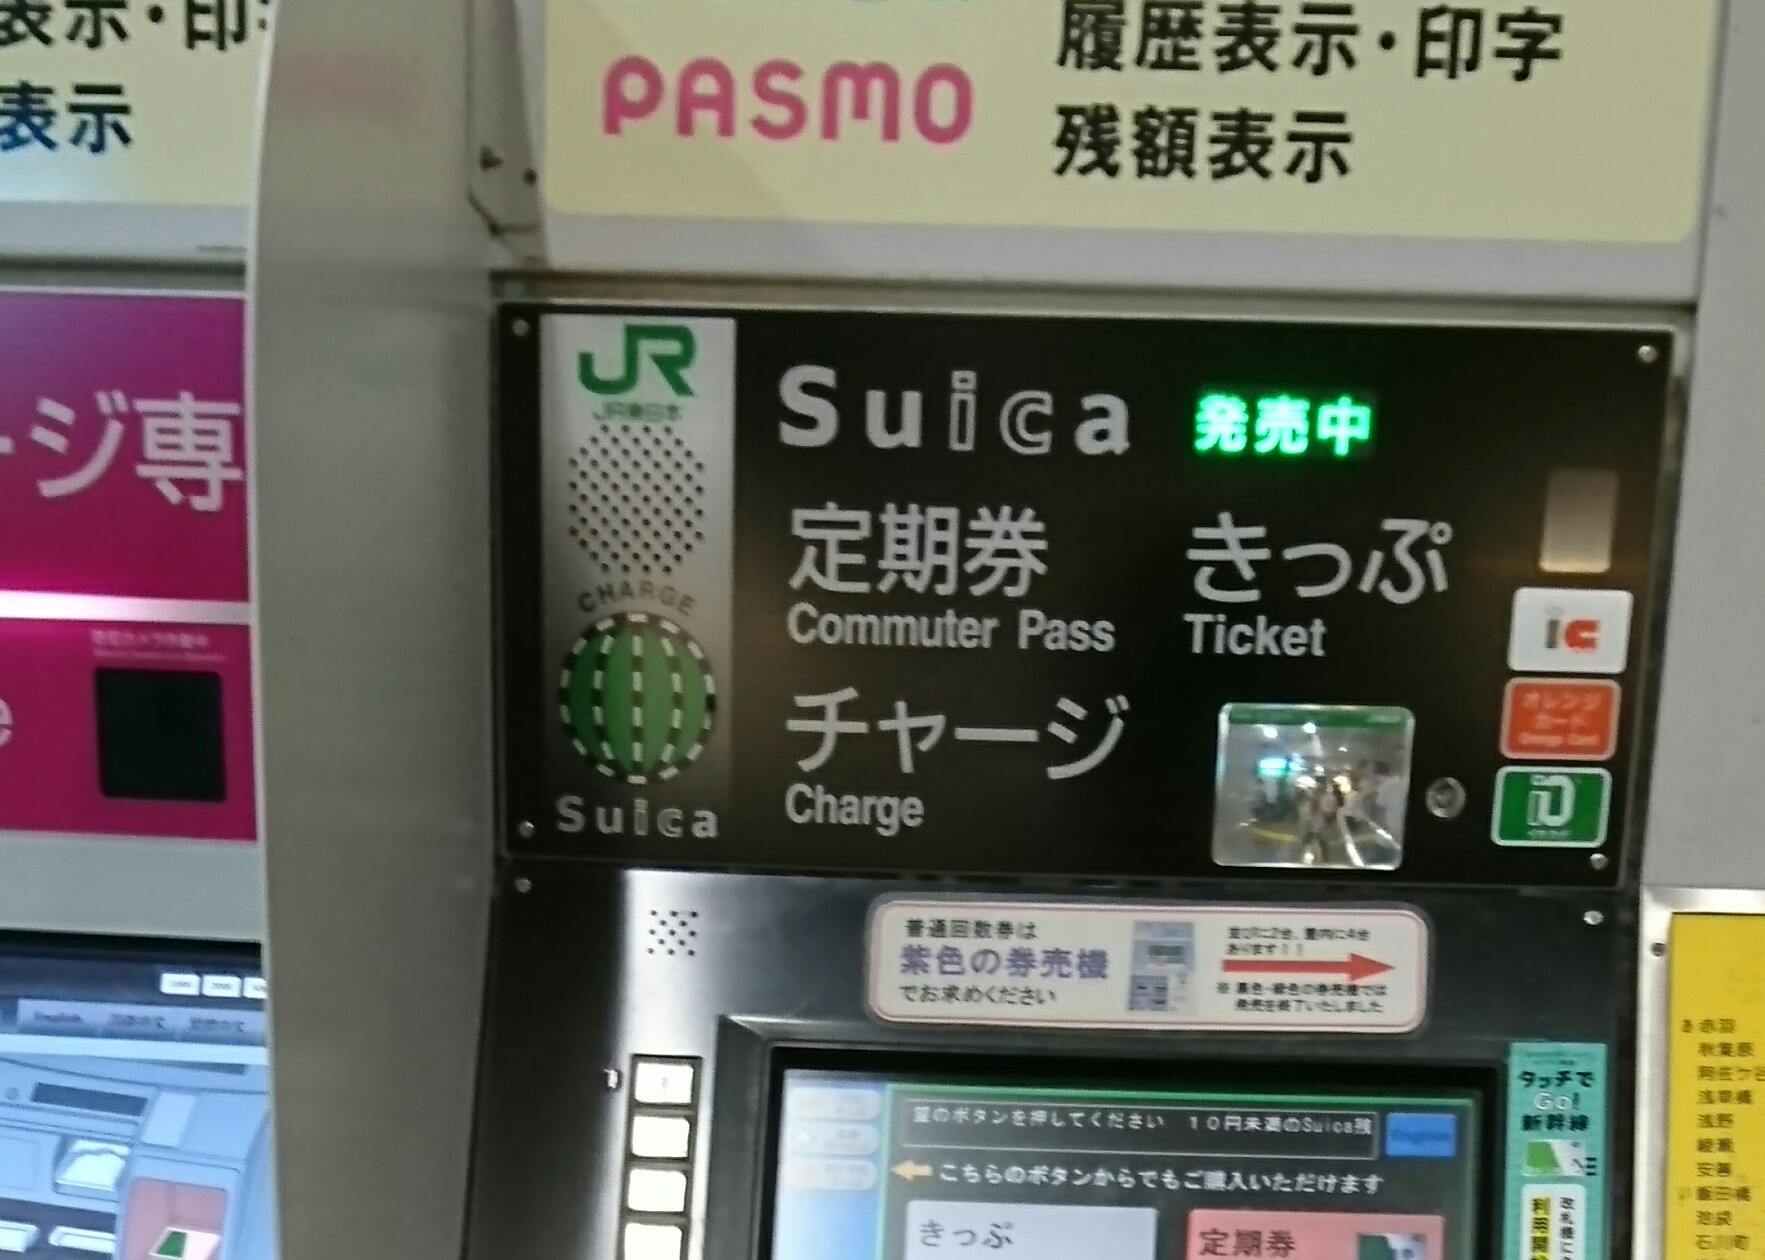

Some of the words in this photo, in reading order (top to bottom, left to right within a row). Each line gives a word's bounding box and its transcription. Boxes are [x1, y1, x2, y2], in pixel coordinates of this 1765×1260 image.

[0, 0, 266, 50] 表示・印
[1055, 0, 1563, 81] 履歴表示・印字
[603, 54, 973, 144] PASMO
[1054, 103, 1352, 183] 残額表示
[578, 323, 696, 396] JR
[778, 365, 1131, 456] Suica
[1194, 392, 1374, 458] 発売中
[788, 502, 1048, 598] 定期券
[1186, 511, 1450, 605] きっぷ
[577, 580, 695, 616] CHARGE
[786, 602, 998, 650] Commuter
[1017, 608, 1116, 653] Pass
[1184, 612, 1328, 657] Ticket
[786, 686, 1131, 780] チャージ
[556, 795, 719, 839] Suica
[784, 782, 925, 836] Charge
[905, 918, 1037, 939] 普通回数券は
[900, 944, 1109, 979] 紫色の券売機
[899, 984, 1057, 1006] でお求めください
[1519, 1070, 1595, 1088] タッチで
[1198, 1227, 1295, 1259] 定期券
